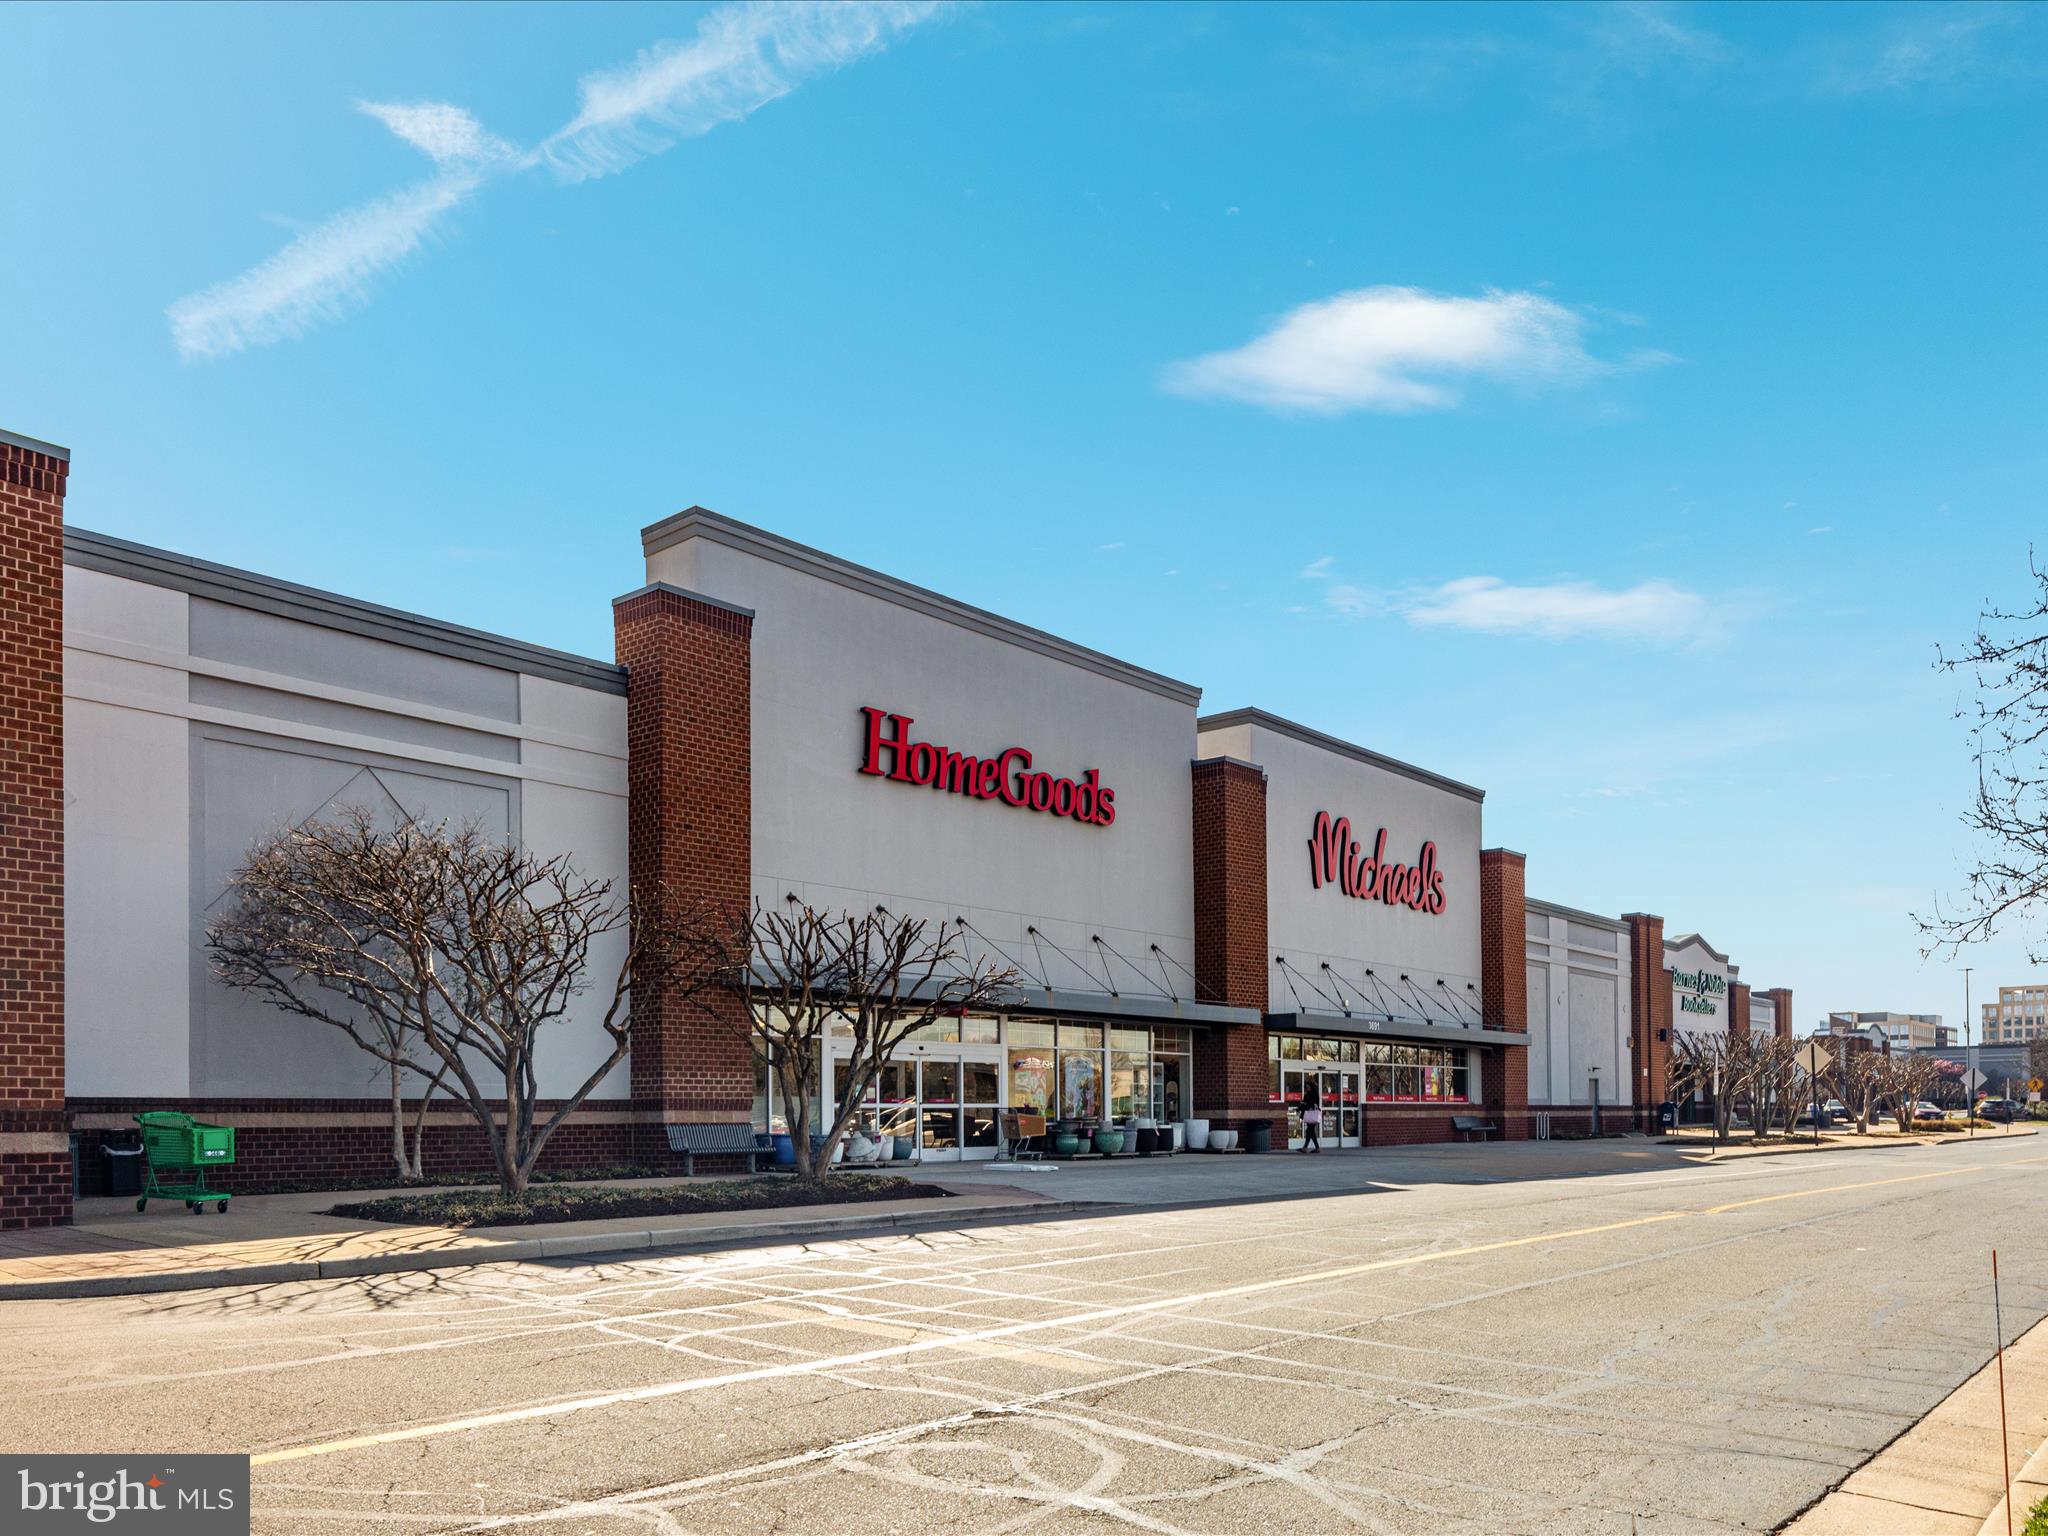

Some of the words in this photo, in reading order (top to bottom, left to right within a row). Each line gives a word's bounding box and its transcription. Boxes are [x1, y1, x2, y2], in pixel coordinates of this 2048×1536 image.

[858, 706, 1116, 826] HomeGoods
[1308, 810, 1446, 915] Michaels
[1671, 966, 1697, 989] Barnes
[1705, 973, 1726, 994] Noble
[1681, 995, 1716, 1016] Booksellers
